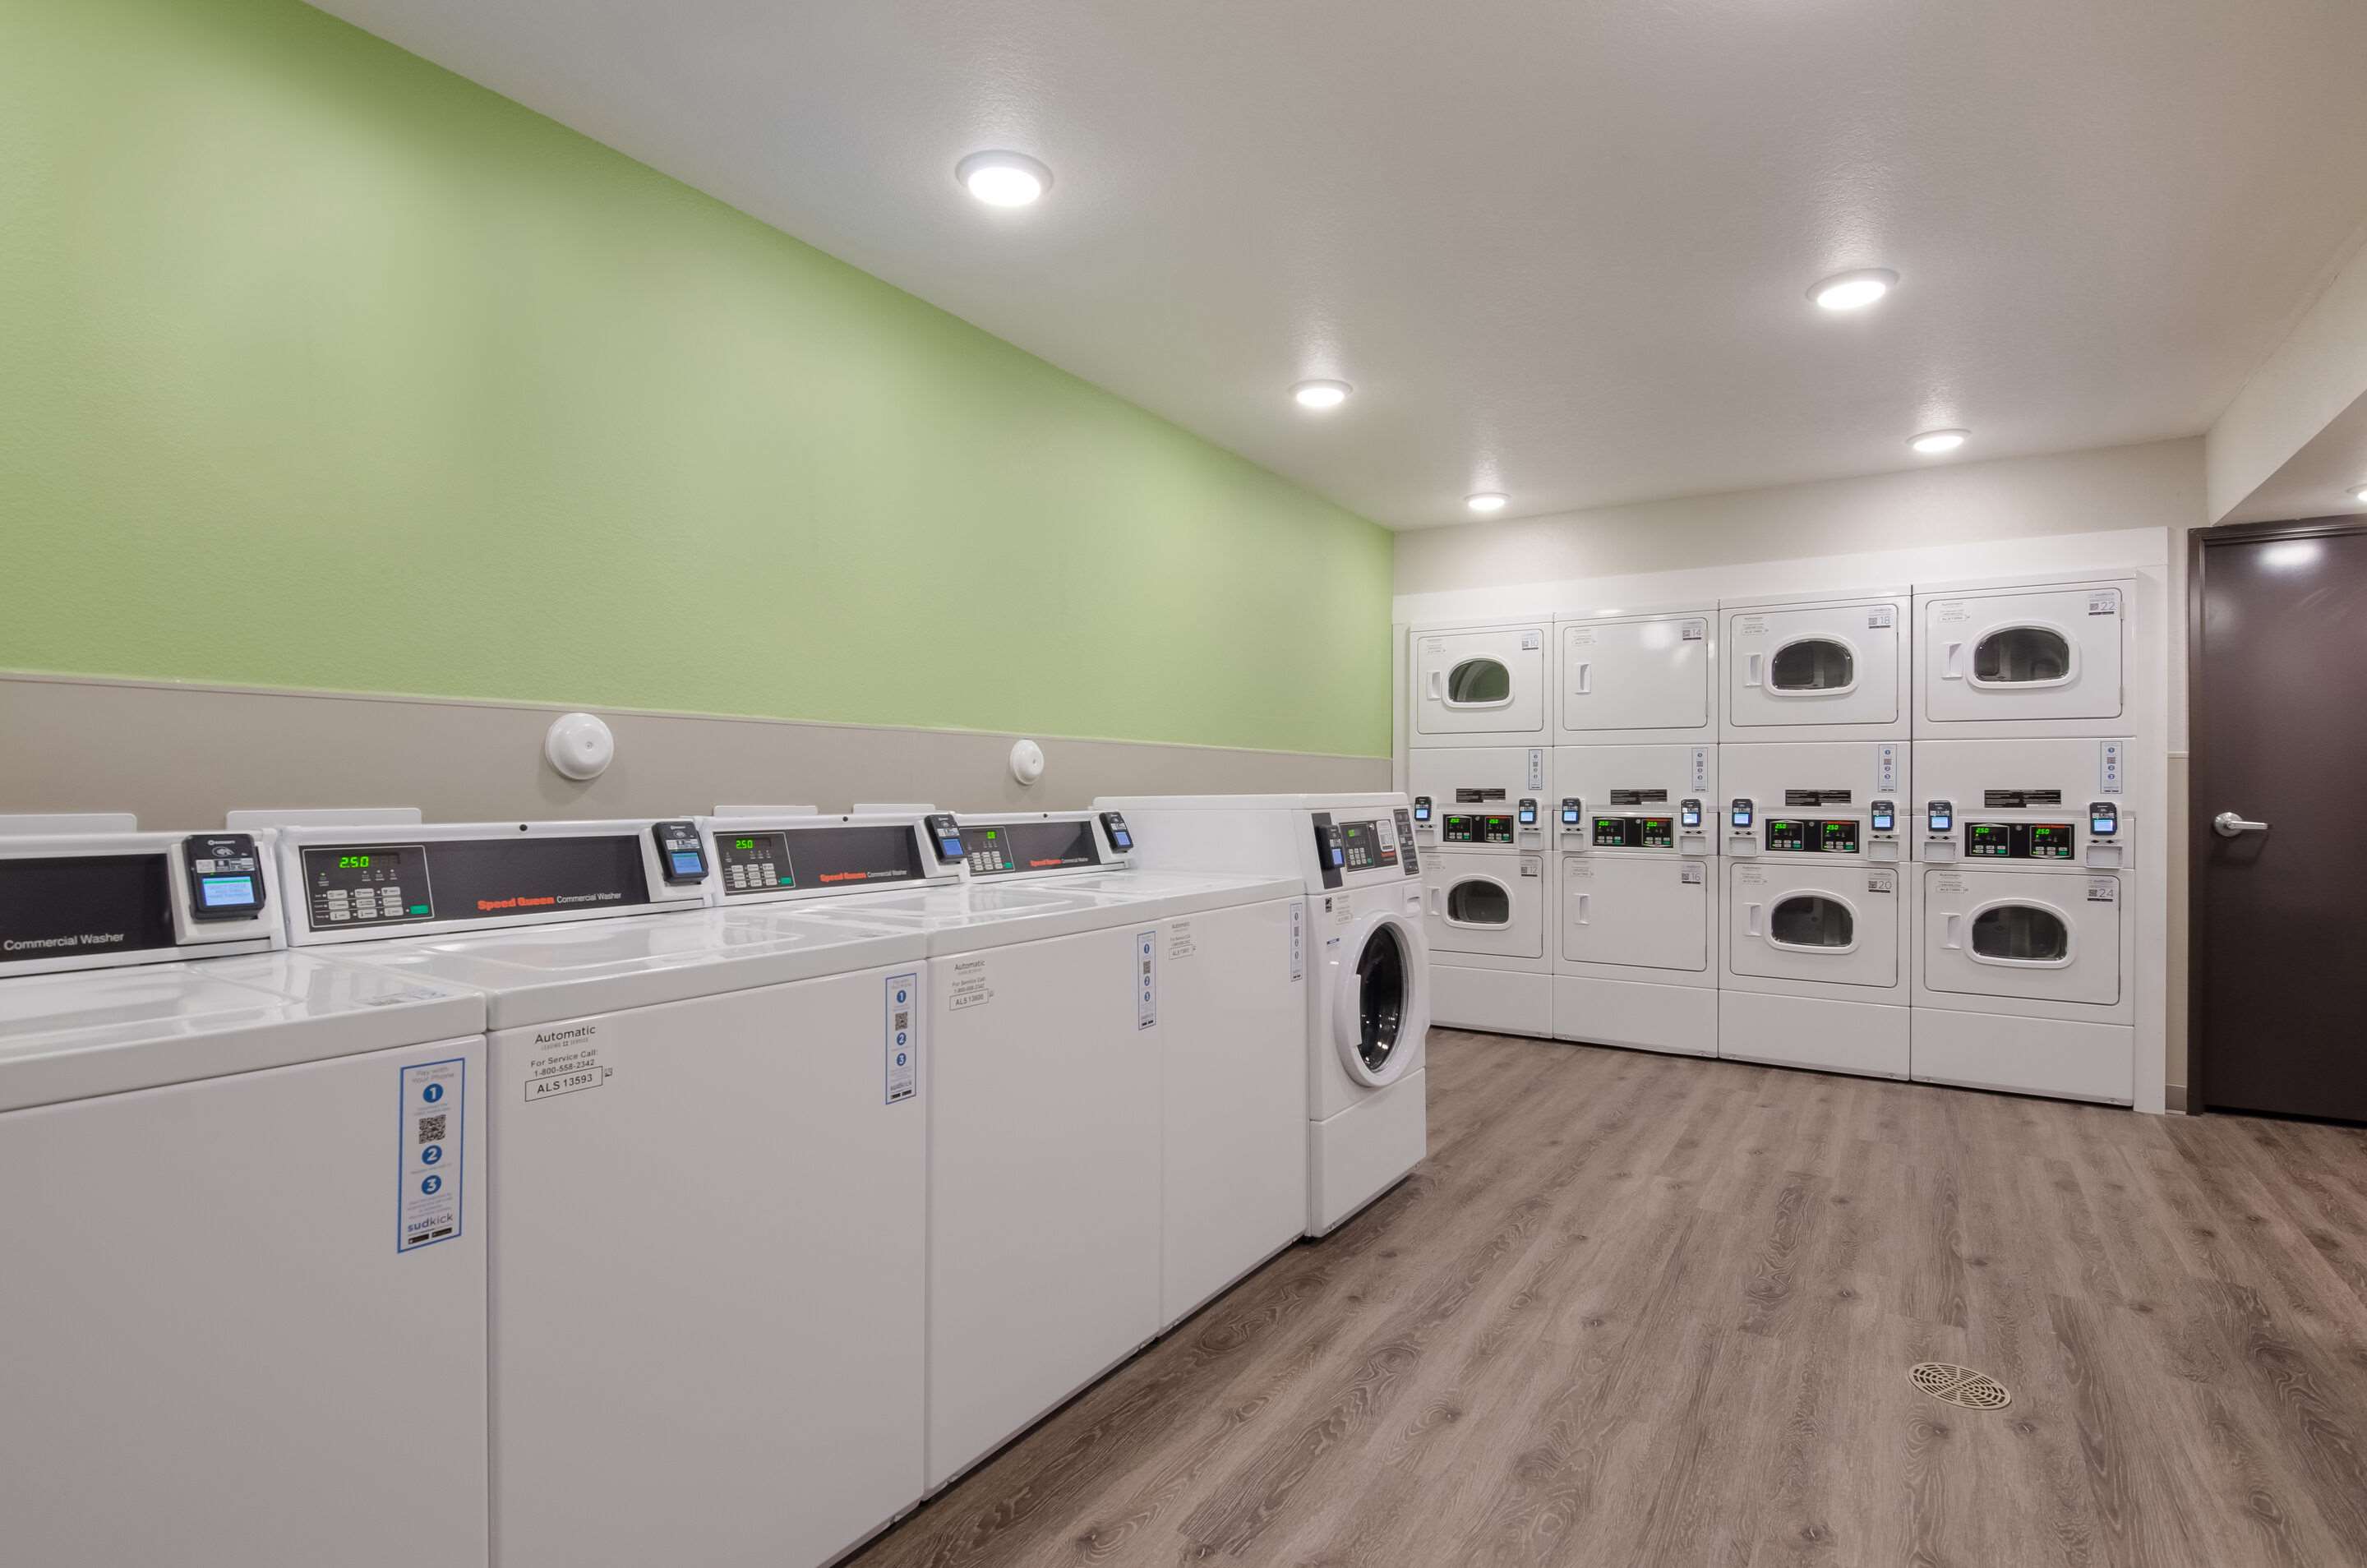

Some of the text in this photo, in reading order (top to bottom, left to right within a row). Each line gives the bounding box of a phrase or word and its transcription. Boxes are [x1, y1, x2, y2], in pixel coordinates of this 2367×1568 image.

[477, 899, 516, 911] Speed
[556, 893, 597, 904] Commercial
[598, 892, 622, 900] Washer
[3, 933, 124, 951] Commercial Washer
[535, 1026, 596, 1044] Automatic
[548, 1054, 579, 1064] Service
[537, 1073, 593, 1094] ALS 13593
[408, 1213, 453, 1232] sudkick
